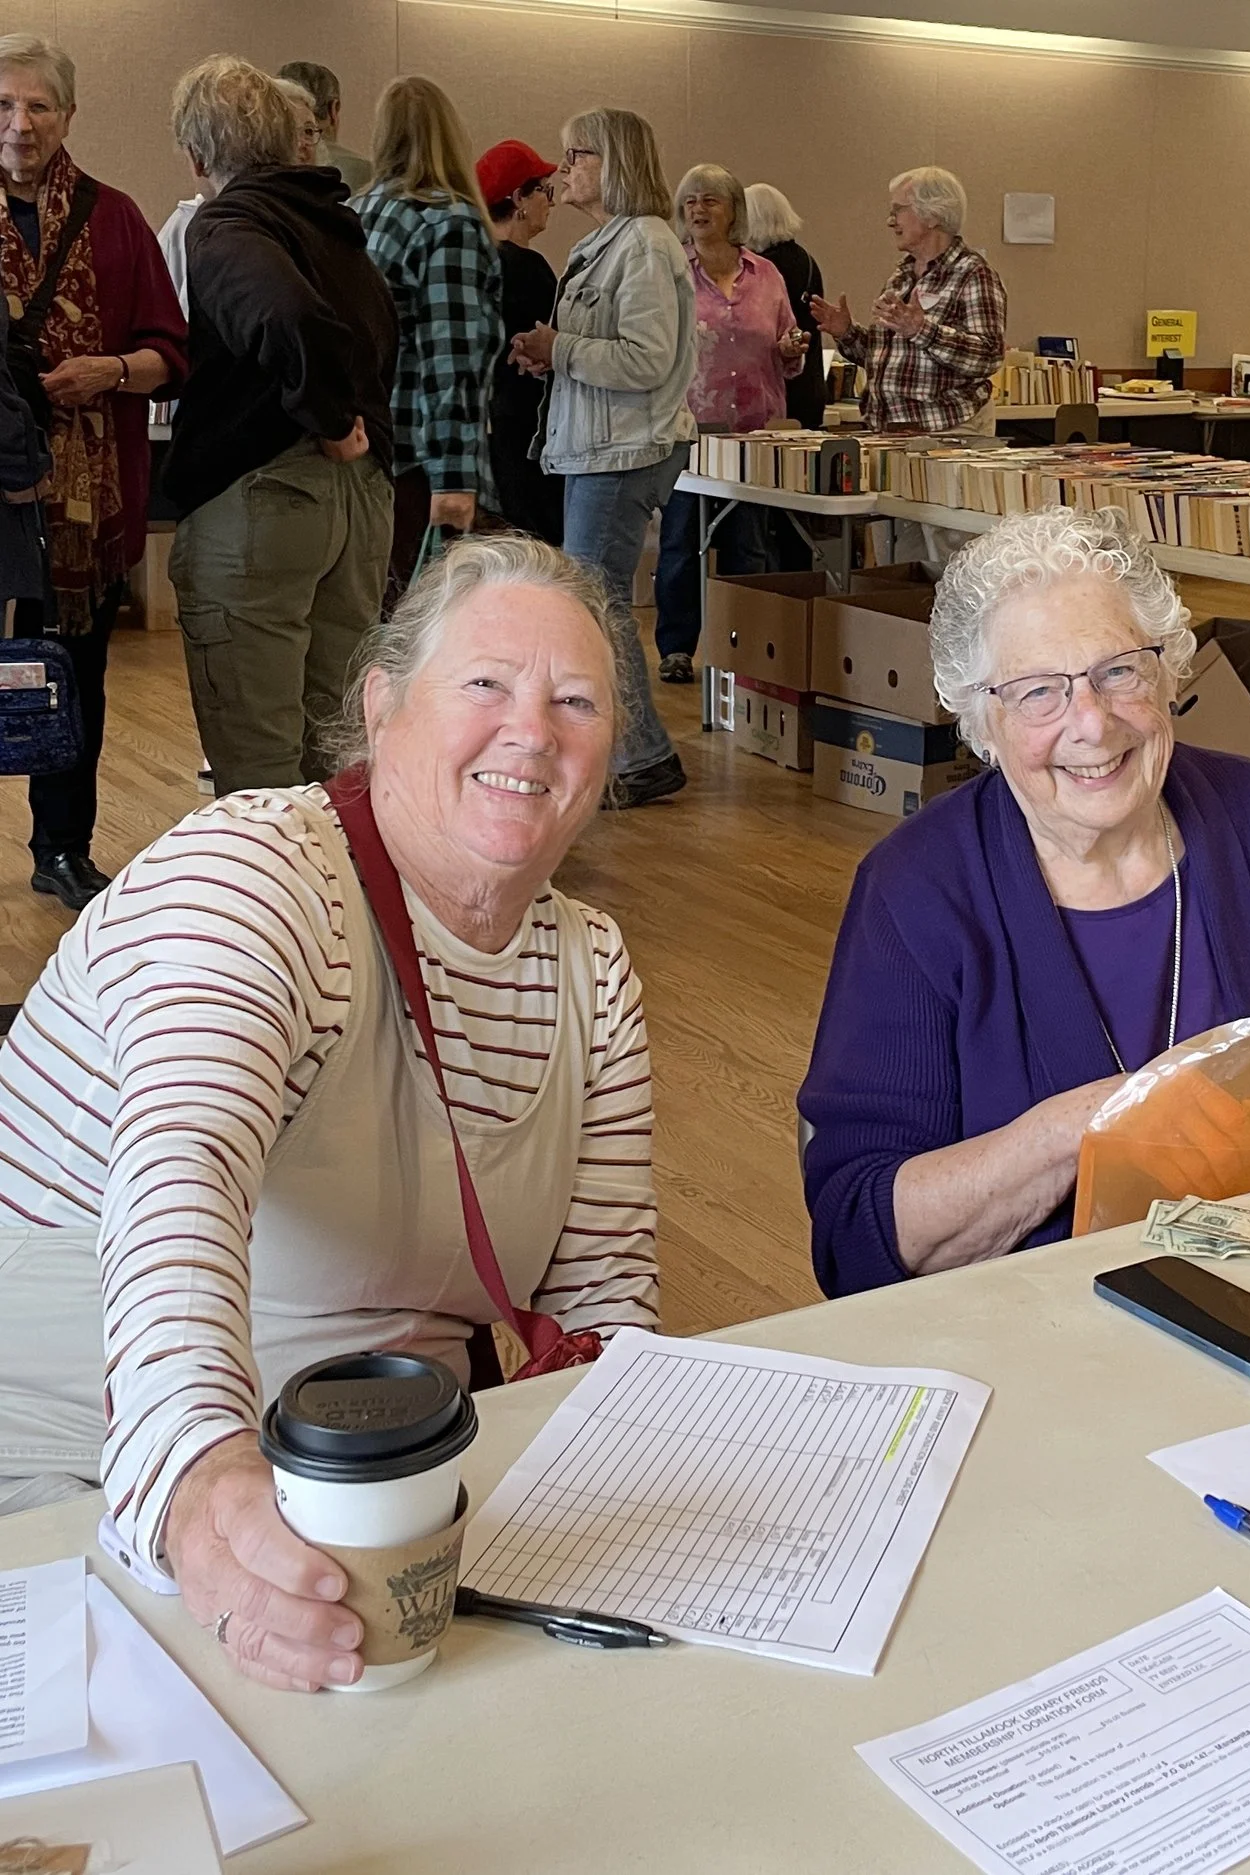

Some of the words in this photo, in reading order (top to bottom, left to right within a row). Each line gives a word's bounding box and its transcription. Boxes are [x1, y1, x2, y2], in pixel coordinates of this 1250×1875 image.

[852, 758, 874, 775] Extra
[839, 769, 887, 797] Corona
[1128, 1654, 1149, 1667] DATE
[918, 1744, 959, 1765] NORTH
[958, 1716, 1020, 1748] TILLAMOOK
[1018, 1696, 1063, 1720] LIBRARY
[1063, 1676, 1108, 1700] FRIENDS
[944, 1731, 1015, 1767] MEMBERSHIP
[1021, 1703, 1076, 1732] DONATION
[1075, 1688, 1107, 1706] FORM
[932, 1774, 978, 1796] Membership
[956, 1795, 994, 1816] Additional
[1034, 1830, 1059, 1844] North
[1056, 1811, 1097, 1832] Tillamook
[1096, 1796, 1126, 1812] Library
[1123, 1782, 1154, 1798] Friends
[1178, 1760, 1195, 1770] Box
